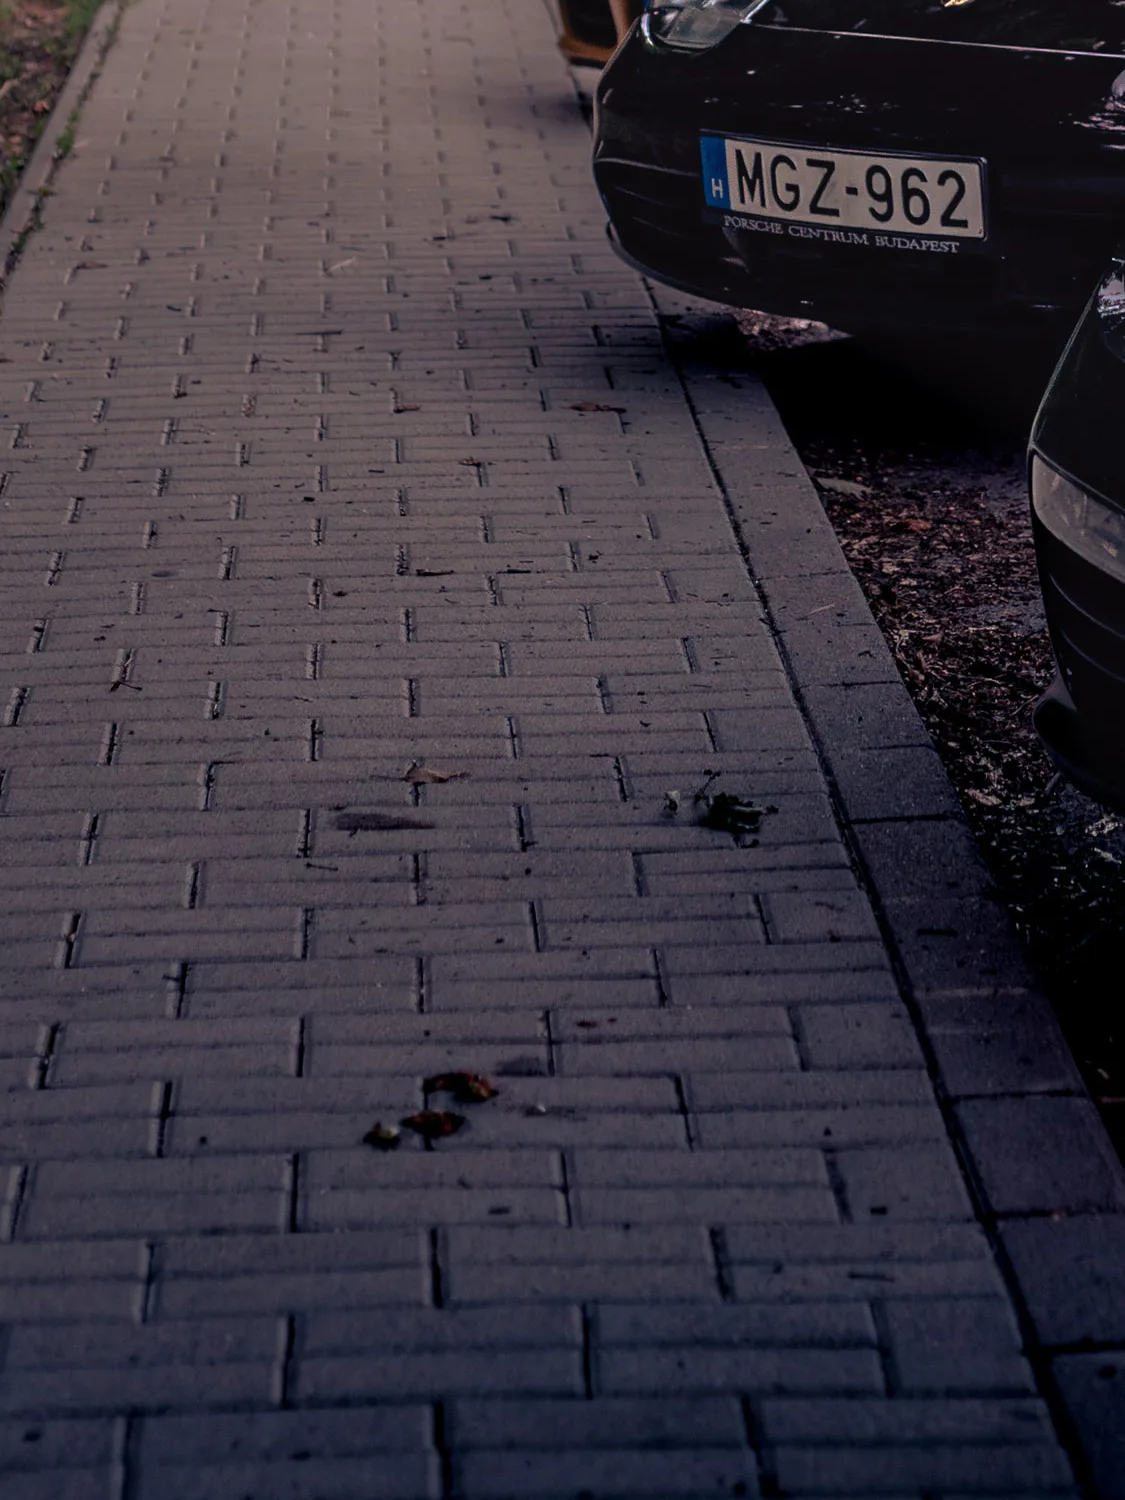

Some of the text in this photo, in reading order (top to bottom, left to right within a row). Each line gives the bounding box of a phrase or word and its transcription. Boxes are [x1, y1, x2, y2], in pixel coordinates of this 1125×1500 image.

[711, 177, 724, 199] H
[735, 148, 969, 229] MGZ-962
[724, 214, 960, 254] PORSCHE CENTRUM BUDAPEST
